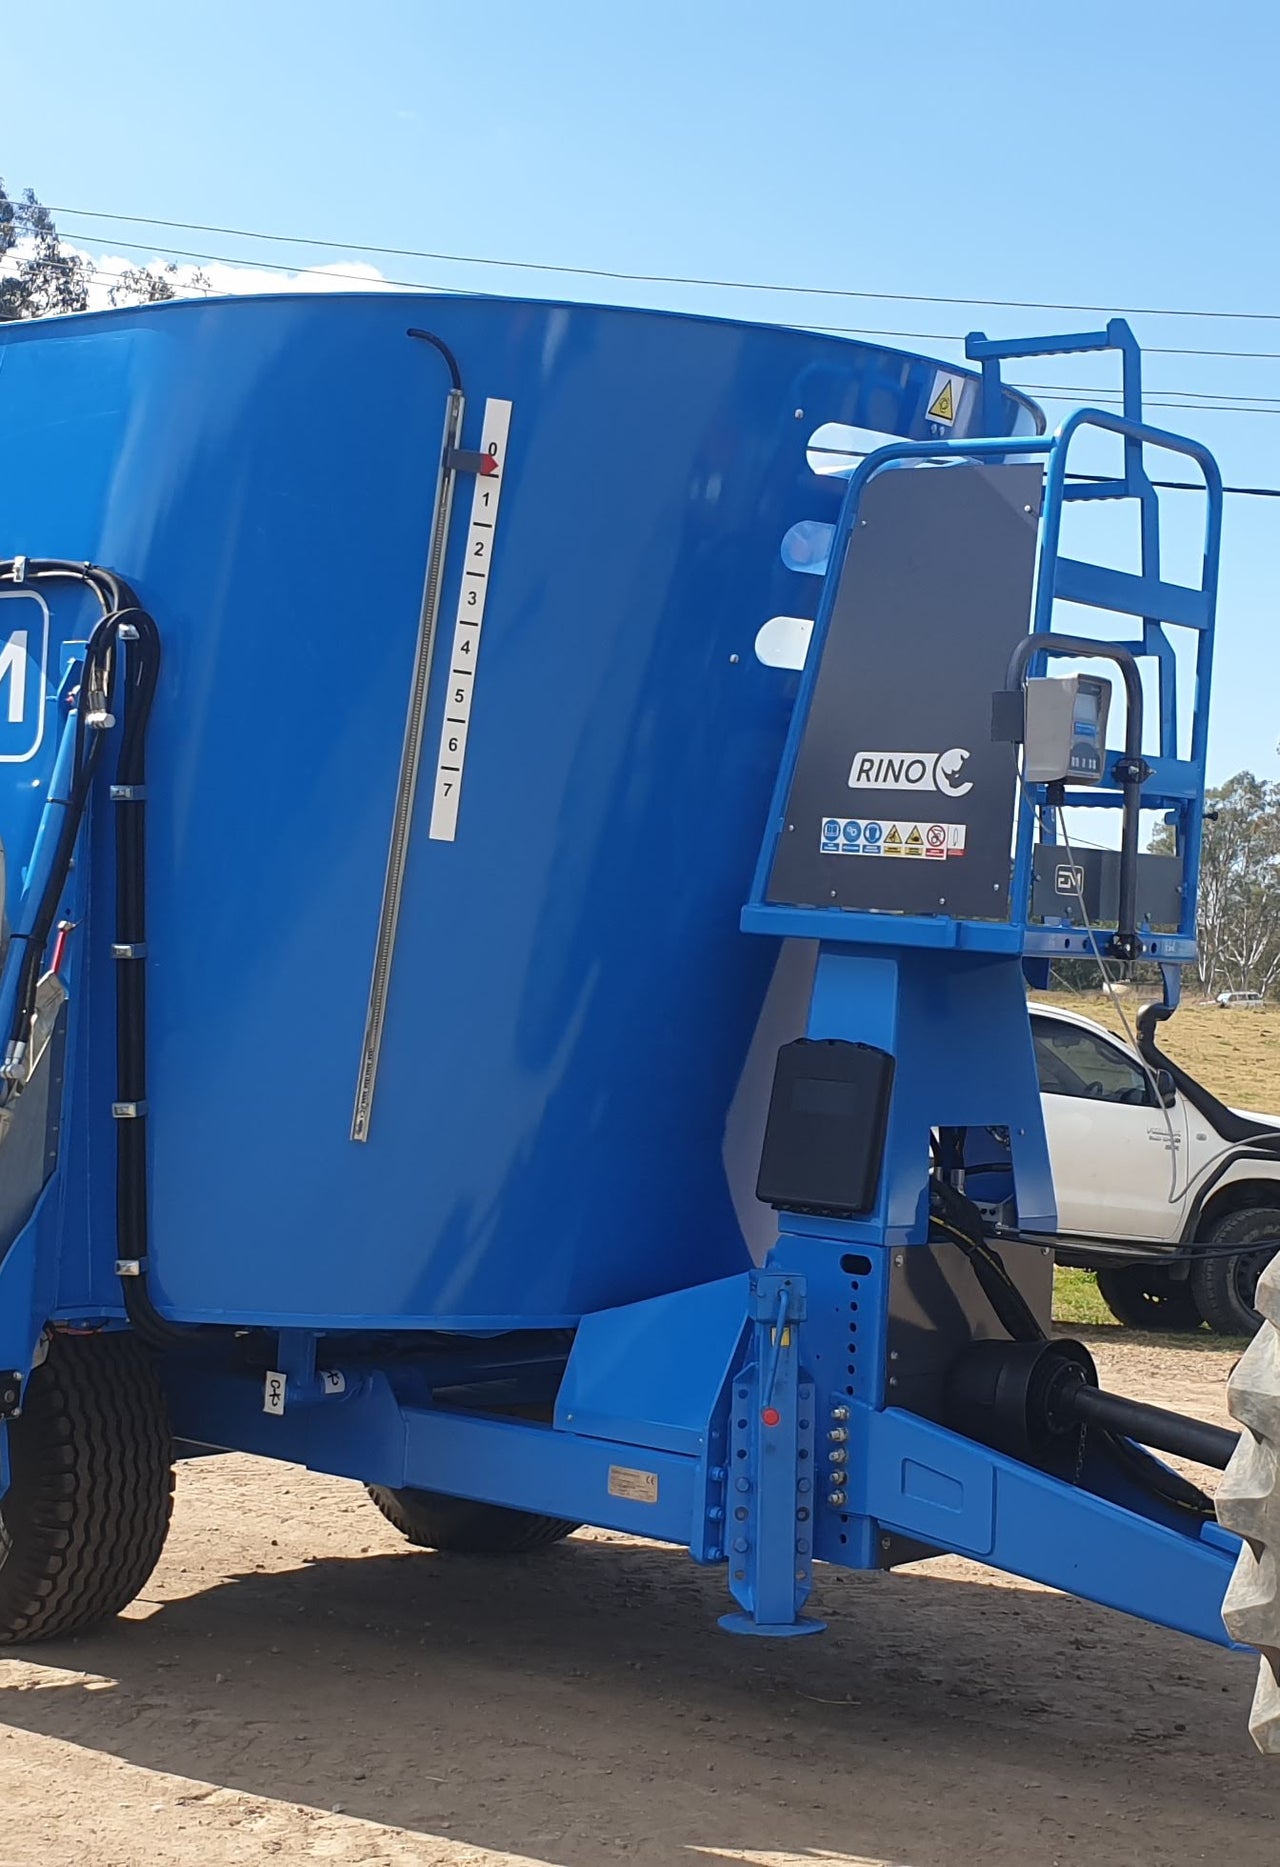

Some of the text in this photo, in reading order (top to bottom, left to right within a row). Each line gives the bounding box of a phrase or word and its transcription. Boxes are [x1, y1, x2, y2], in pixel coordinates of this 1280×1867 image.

[488, 442, 498, 457] 0
[482, 492, 490, 506] 1
[473, 542, 484, 556] 2
[467, 591, 477, 606] 3
[460, 640, 471, 655] 4
[454, 688, 465, 703] 5
[448, 737, 458, 752] 6
[856, 758, 927, 784] RINO
[443, 783, 453, 797] 7
